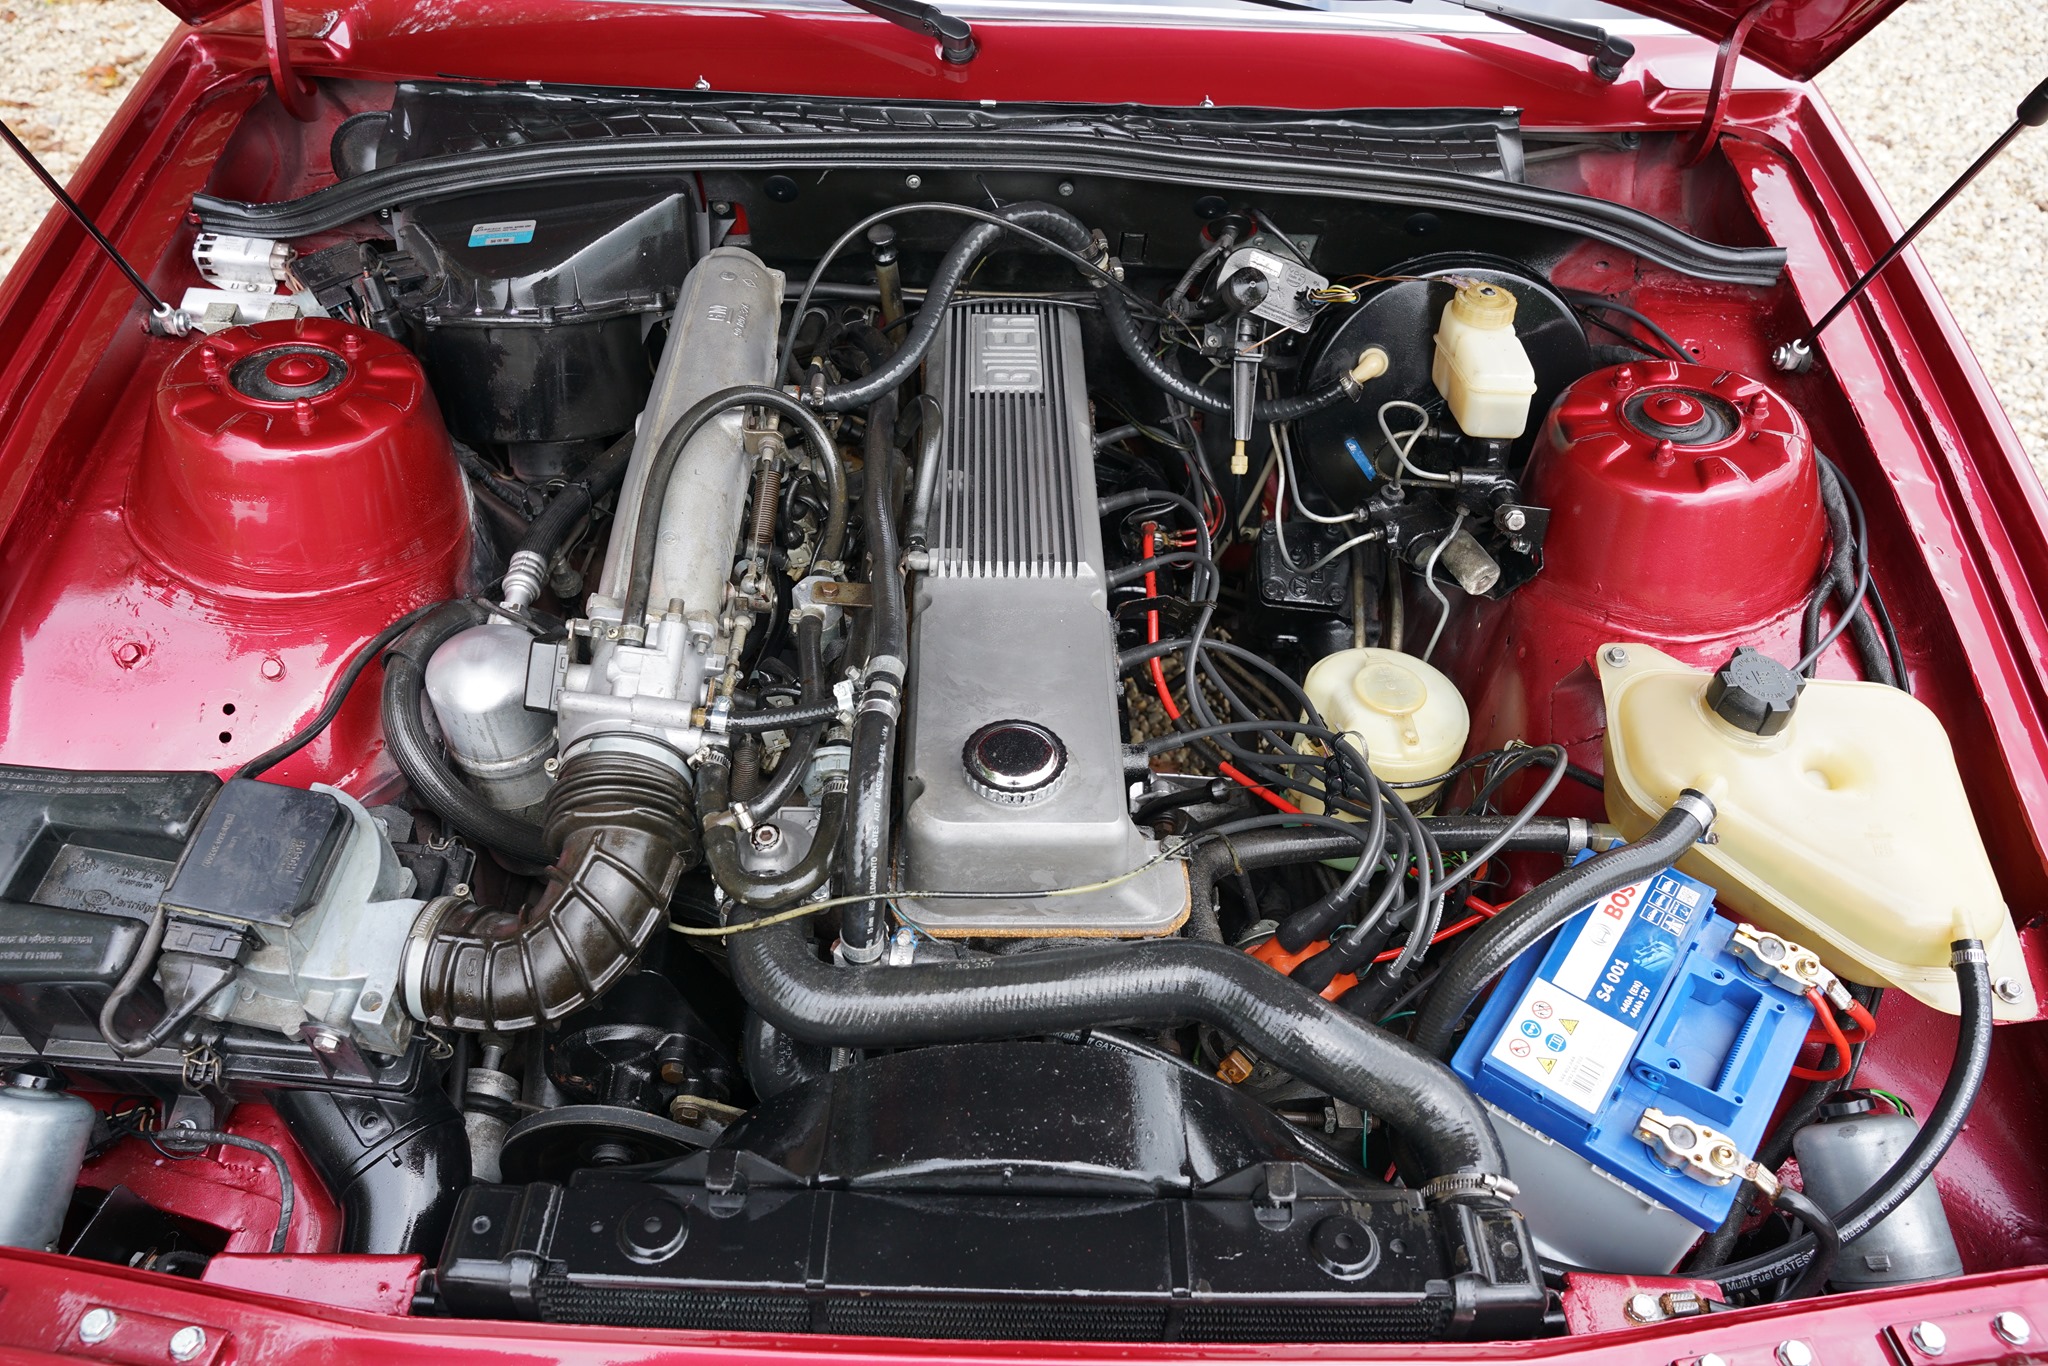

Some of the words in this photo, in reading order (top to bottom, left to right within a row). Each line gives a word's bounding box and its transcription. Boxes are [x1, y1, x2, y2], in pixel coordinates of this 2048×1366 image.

[876, 772, 884, 798] MASTER
[1595, 982, 1616, 1003] S4
[1606, 958, 1630, 984] 001
[1620, 994, 1635, 1014] 440A
[1628, 980, 1643, 997] (EN)
[1629, 1000, 1645, 1019] 44Ah
[1638, 986, 1651, 1002] 12V
[1878, 1203, 1890, 1214] 10
[1889, 1187, 1906, 1206] mm
[1902, 1171, 1923, 1192] Multi
[1919, 1129, 1953, 1171] Carburant
[1979, 970, 1989, 994] 3225
[1725, 1279, 1750, 1292] Multi
[1751, 1272, 1774, 1285] Fuel
